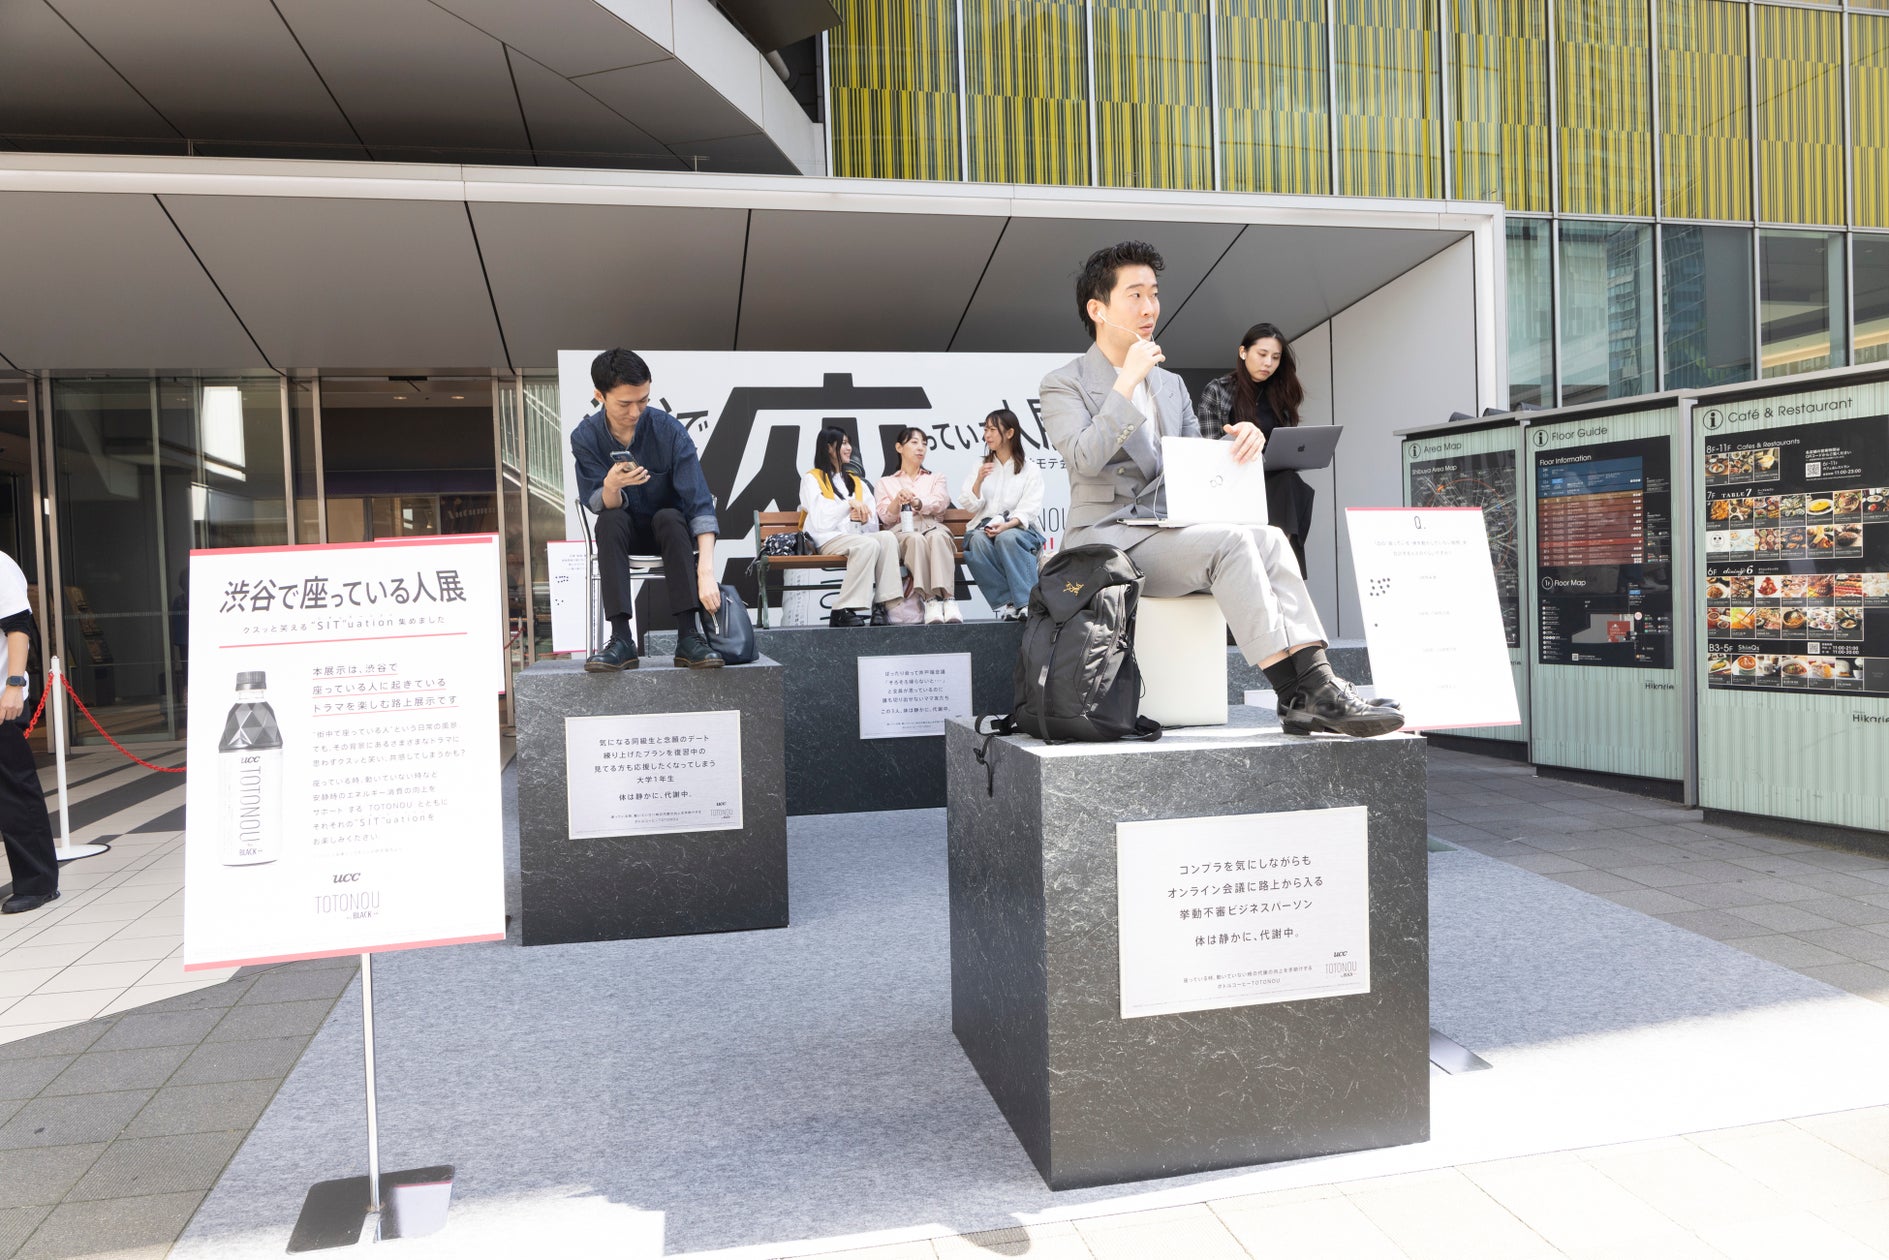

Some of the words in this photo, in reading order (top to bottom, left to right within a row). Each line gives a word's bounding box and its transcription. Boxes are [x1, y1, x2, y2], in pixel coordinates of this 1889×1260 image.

[1727, 408, 1760, 423] Café
[1764, 407, 1774, 418] &
[1778, 397, 1853, 416] Restaurant
[1551, 428, 1575, 441] Floor
[1577, 425, 1608, 438] Guide
[1424, 445, 1442, 454] Area
[1444, 442, 1462, 451] Map
[1762, 438, 1801, 448] Restaurants
[1555, 454, 1592, 465] Information
[218, 569, 467, 614] 渋谷で座っている人展
[1554, 579, 1570, 587] Floor
[1571, 579, 1587, 587] Map
[243, 623, 308, 634] クスッと笑える
[398, 616, 445, 626] 集めました
[312, 678, 447, 695] 座っている人に起きている
[1645, 682, 1675, 690] Hikarie
[594, 760, 716, 773] 見てる方も応援したくなってしまう
[636, 775, 675, 784] 大学1年生
[619, 790, 692, 802] 体は静かに、代謝中。
[239, 766, 261, 844] TOTONOU
[1179, 855, 1312, 876] コンプラを気にしながらも
[1167, 876, 1324, 899] オンライン会議に路上から入る
[315, 891, 380, 914] TOTONOU
[1179, 900, 1313, 921] 挙動不審ビジネスパーソン
[1195, 927, 1300, 947] 体は静かに、代謝中。
